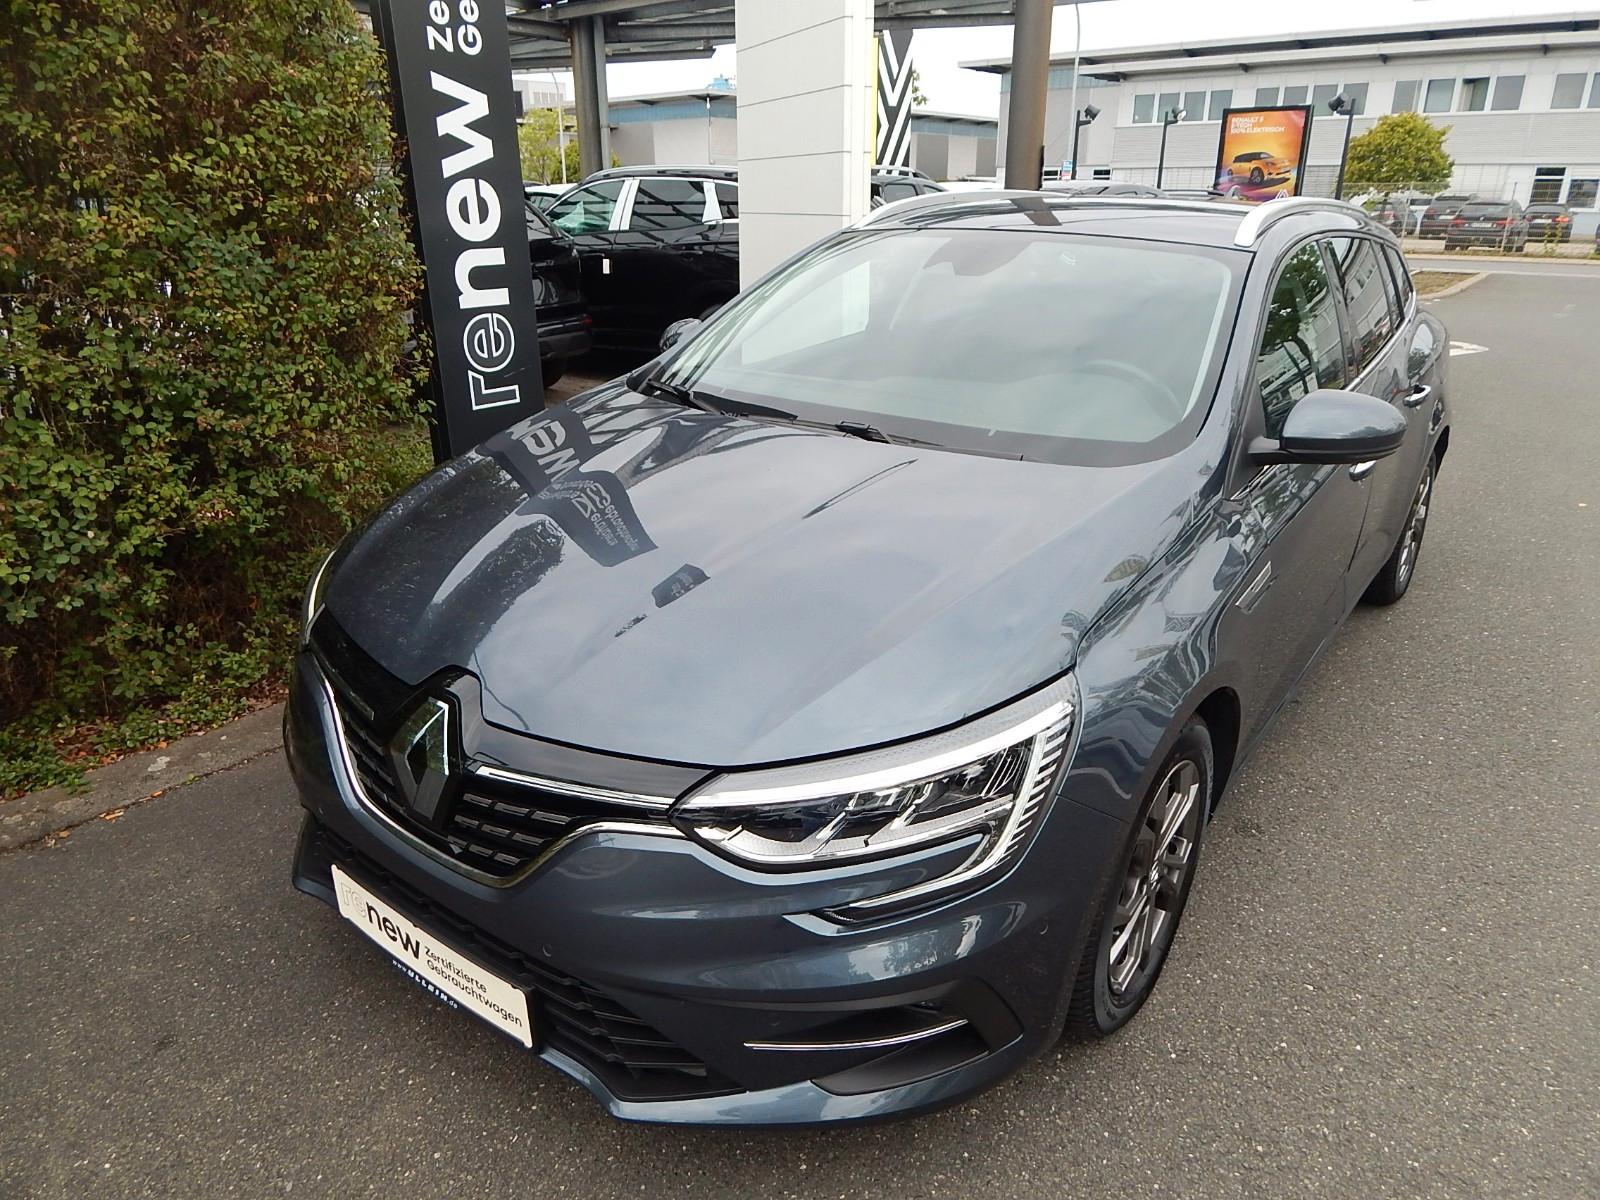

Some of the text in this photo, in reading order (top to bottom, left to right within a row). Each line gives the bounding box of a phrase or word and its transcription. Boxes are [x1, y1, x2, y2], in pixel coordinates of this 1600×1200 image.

[430, 70, 520, 411] renew
[424, 945, 487, 994] Zertifizierte
[426, 959, 523, 1028] Gebrauchtwagen
